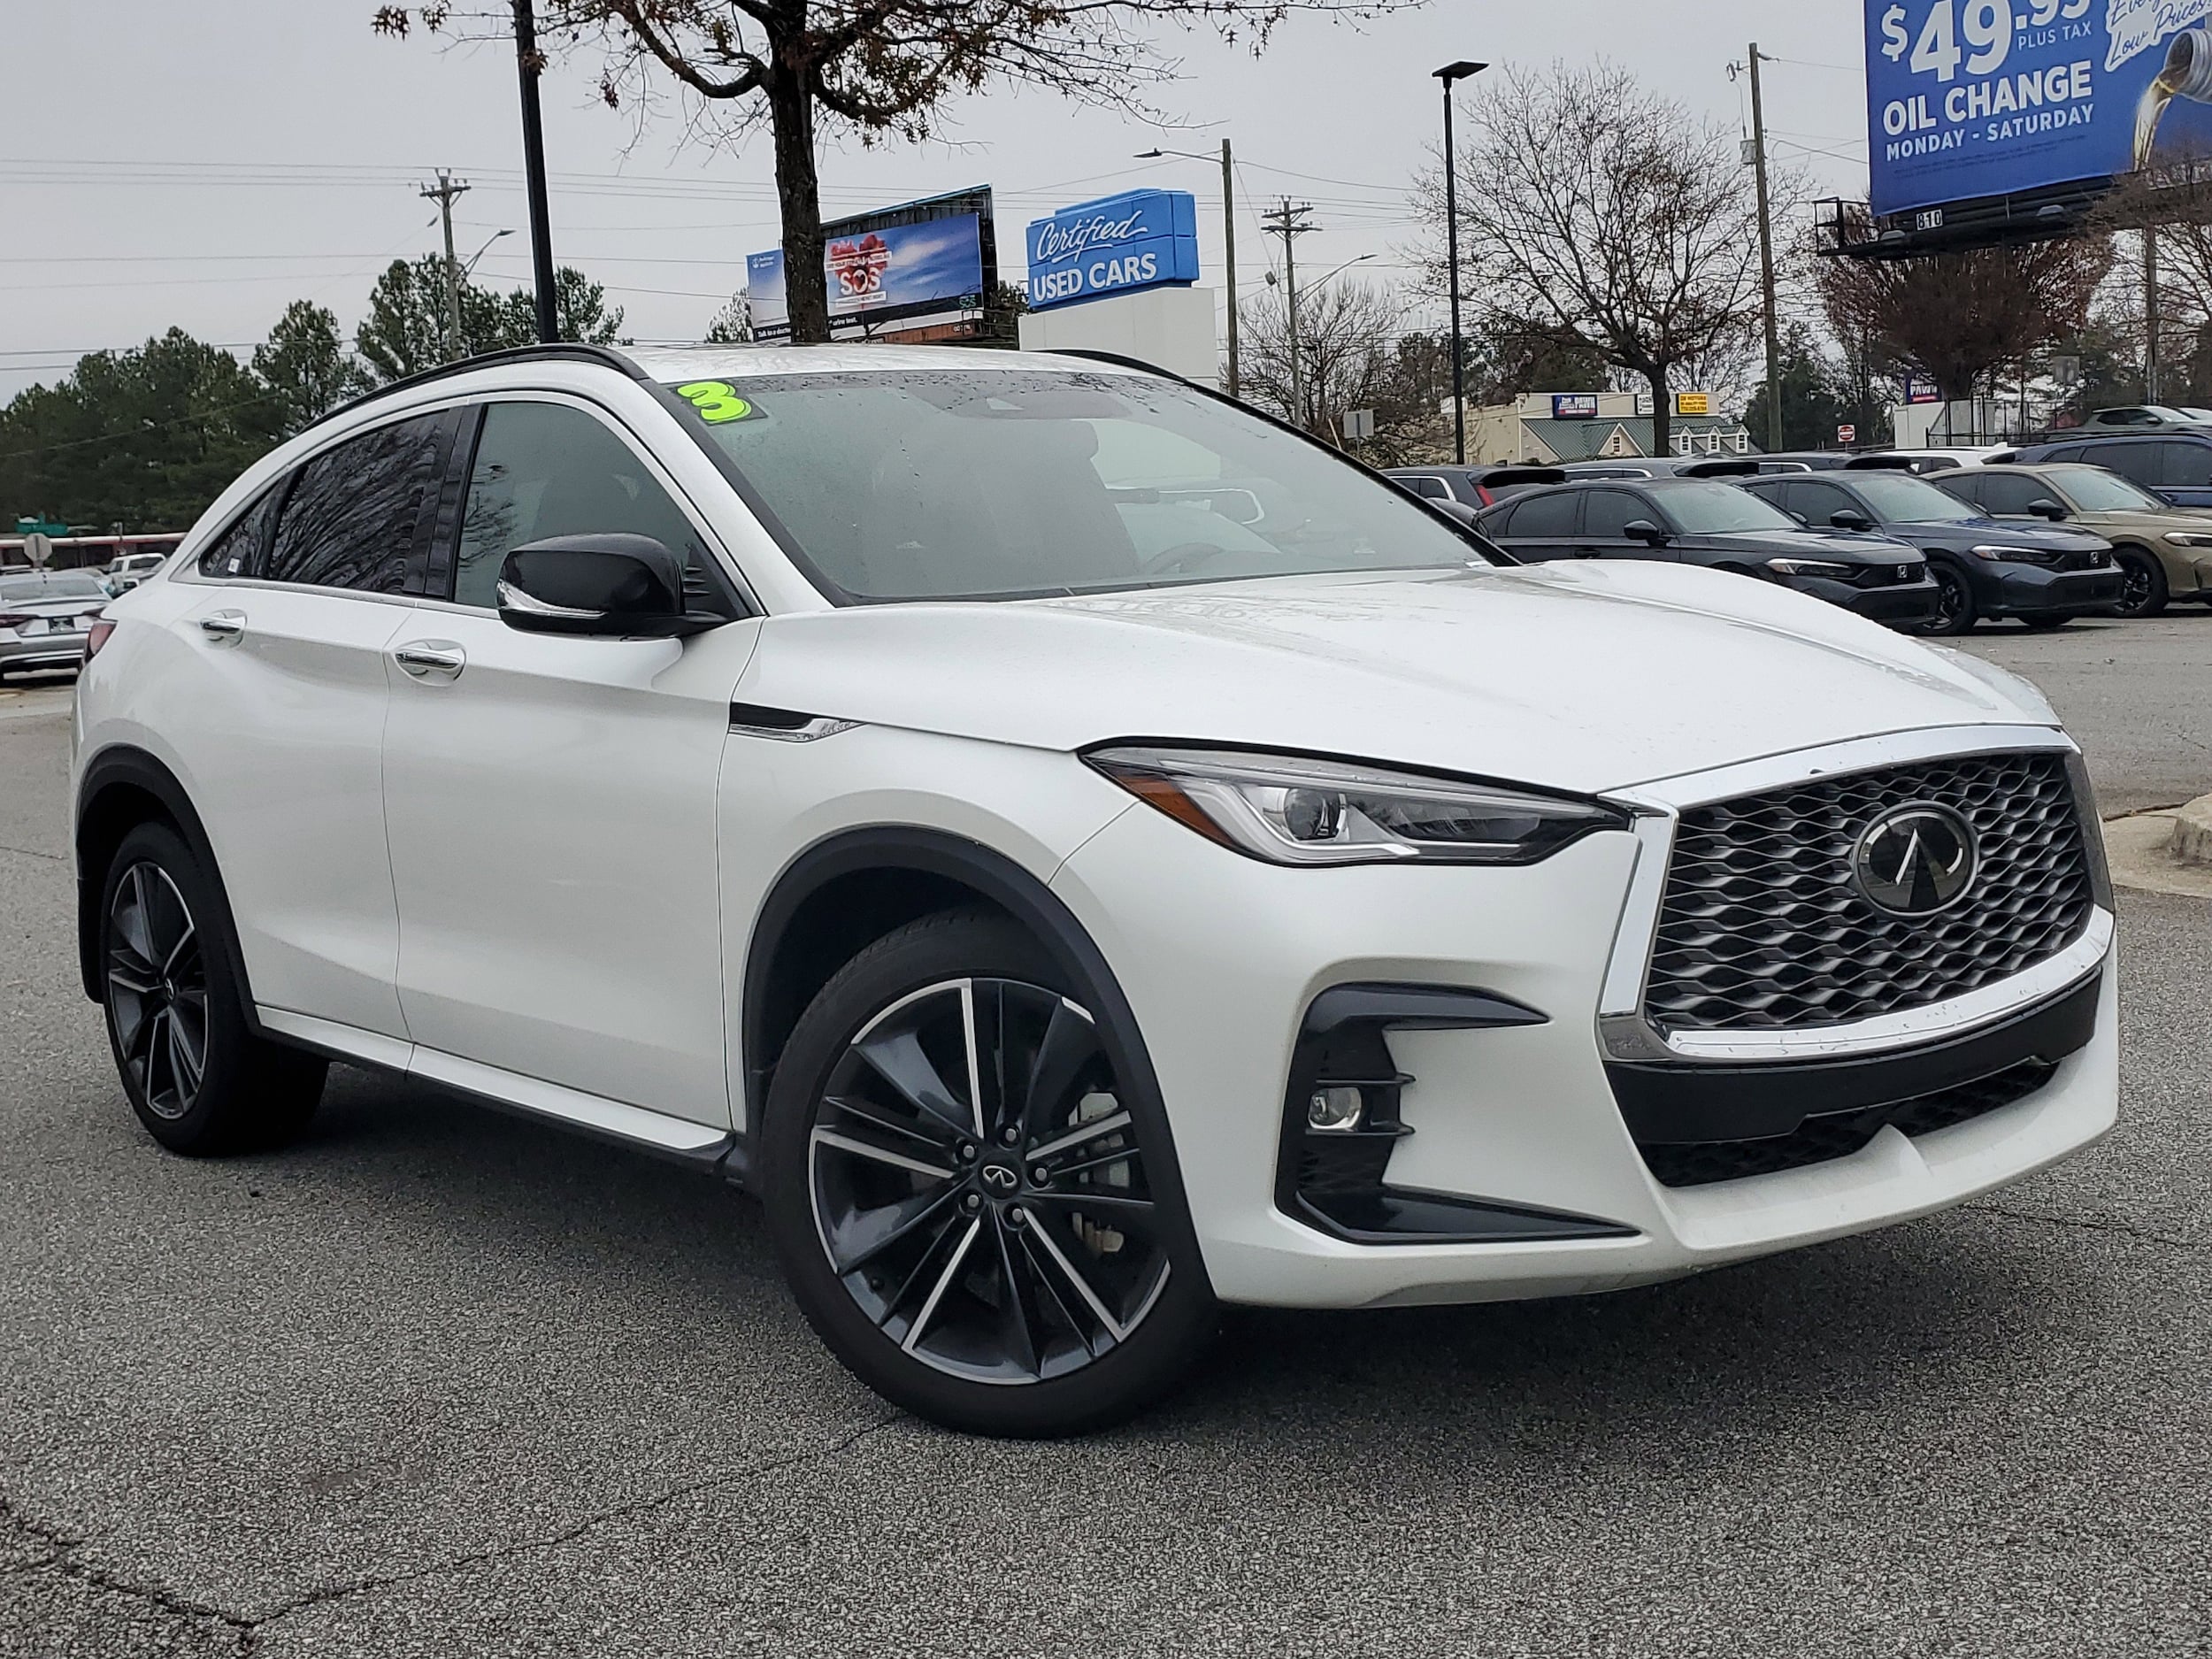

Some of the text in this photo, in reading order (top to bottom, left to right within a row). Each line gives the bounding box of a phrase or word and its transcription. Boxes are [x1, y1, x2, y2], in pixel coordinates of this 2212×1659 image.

[2018, 21, 2092, 50] PLUS TAX
[2109, 31, 2148, 66] Low
[1883, 60, 2093, 135] OIL CHANGE
[1886, 129, 1965, 161] MONDAY
[1986, 104, 2094, 142] SATURDAY
[1037, 210, 1148, 263] Certified
[1917, 211, 1942, 228] 810
[840, 267, 880, 295] SOS
[1033, 253, 1157, 302] USED CARS
[677, 381, 751, 425] 3
